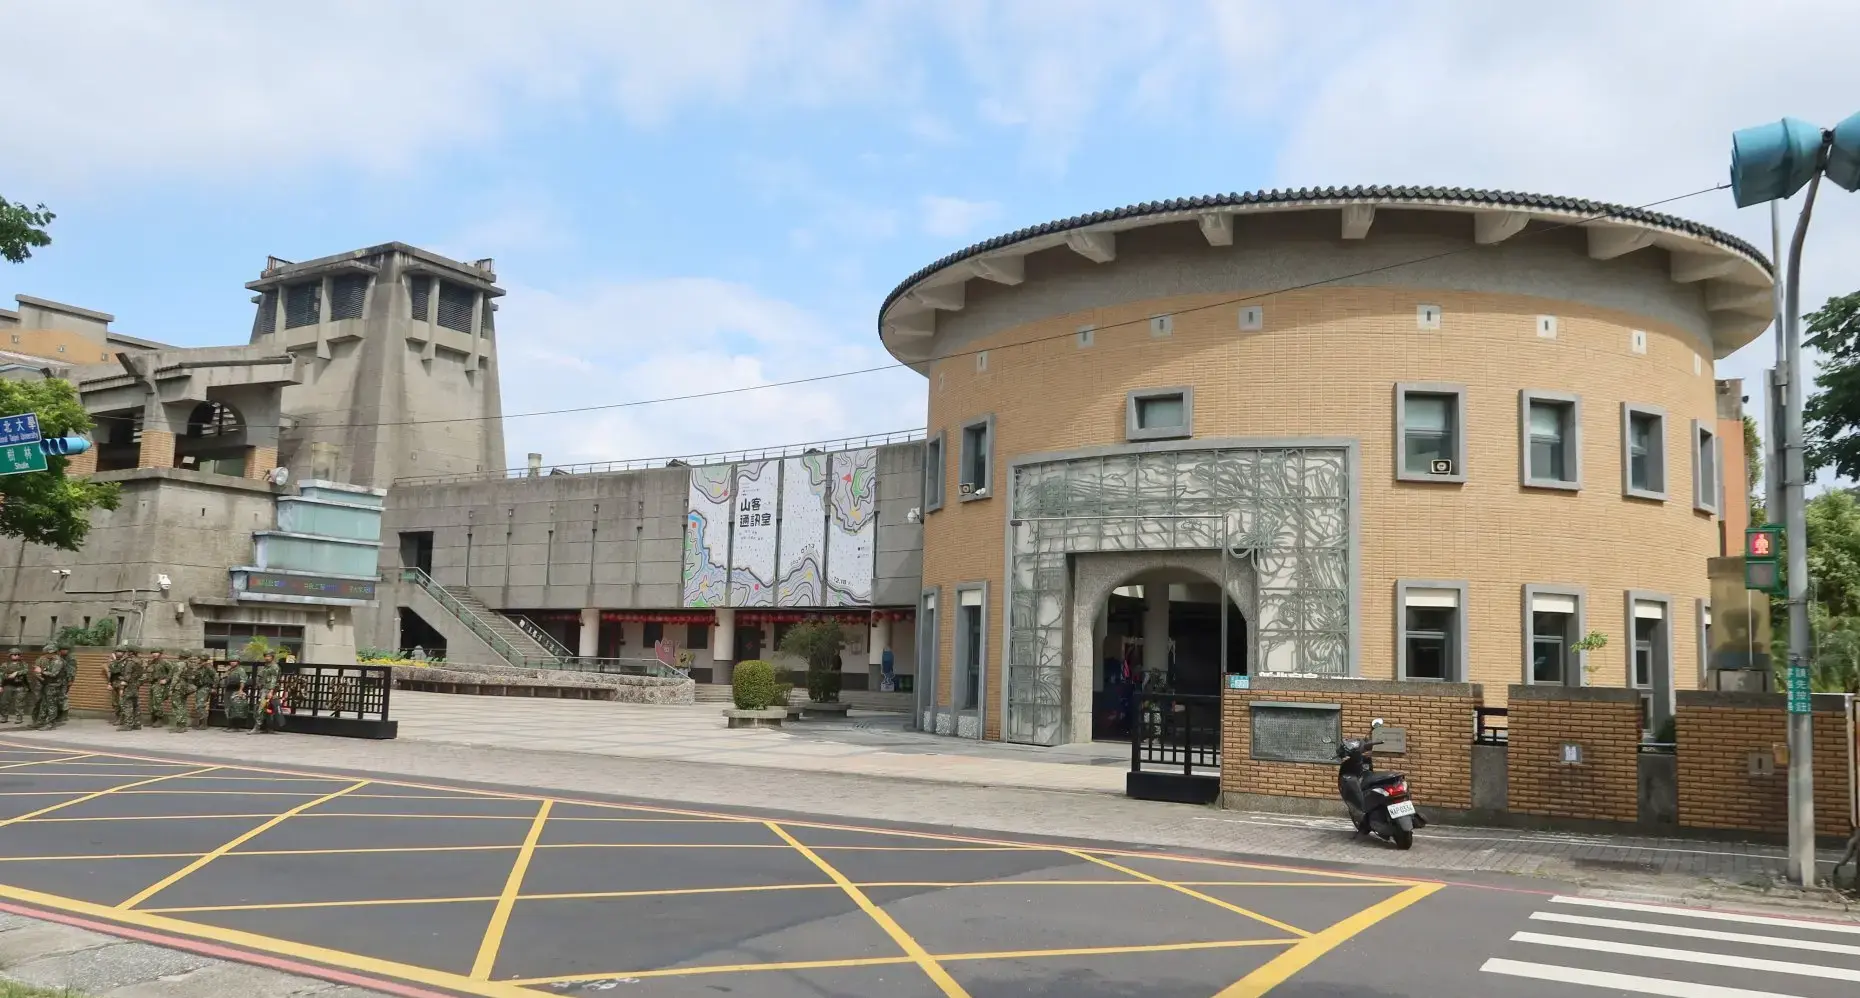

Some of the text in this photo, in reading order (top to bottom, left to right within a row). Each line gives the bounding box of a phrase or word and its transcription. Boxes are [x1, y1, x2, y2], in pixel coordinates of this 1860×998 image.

[3, 416, 36, 433] 北大學
[7, 446, 32, 462] 樹林
[15, 462, 30, 470] Shulin
[741, 497, 761, 511] 山客
[740, 513, 771, 527] 通訊室
